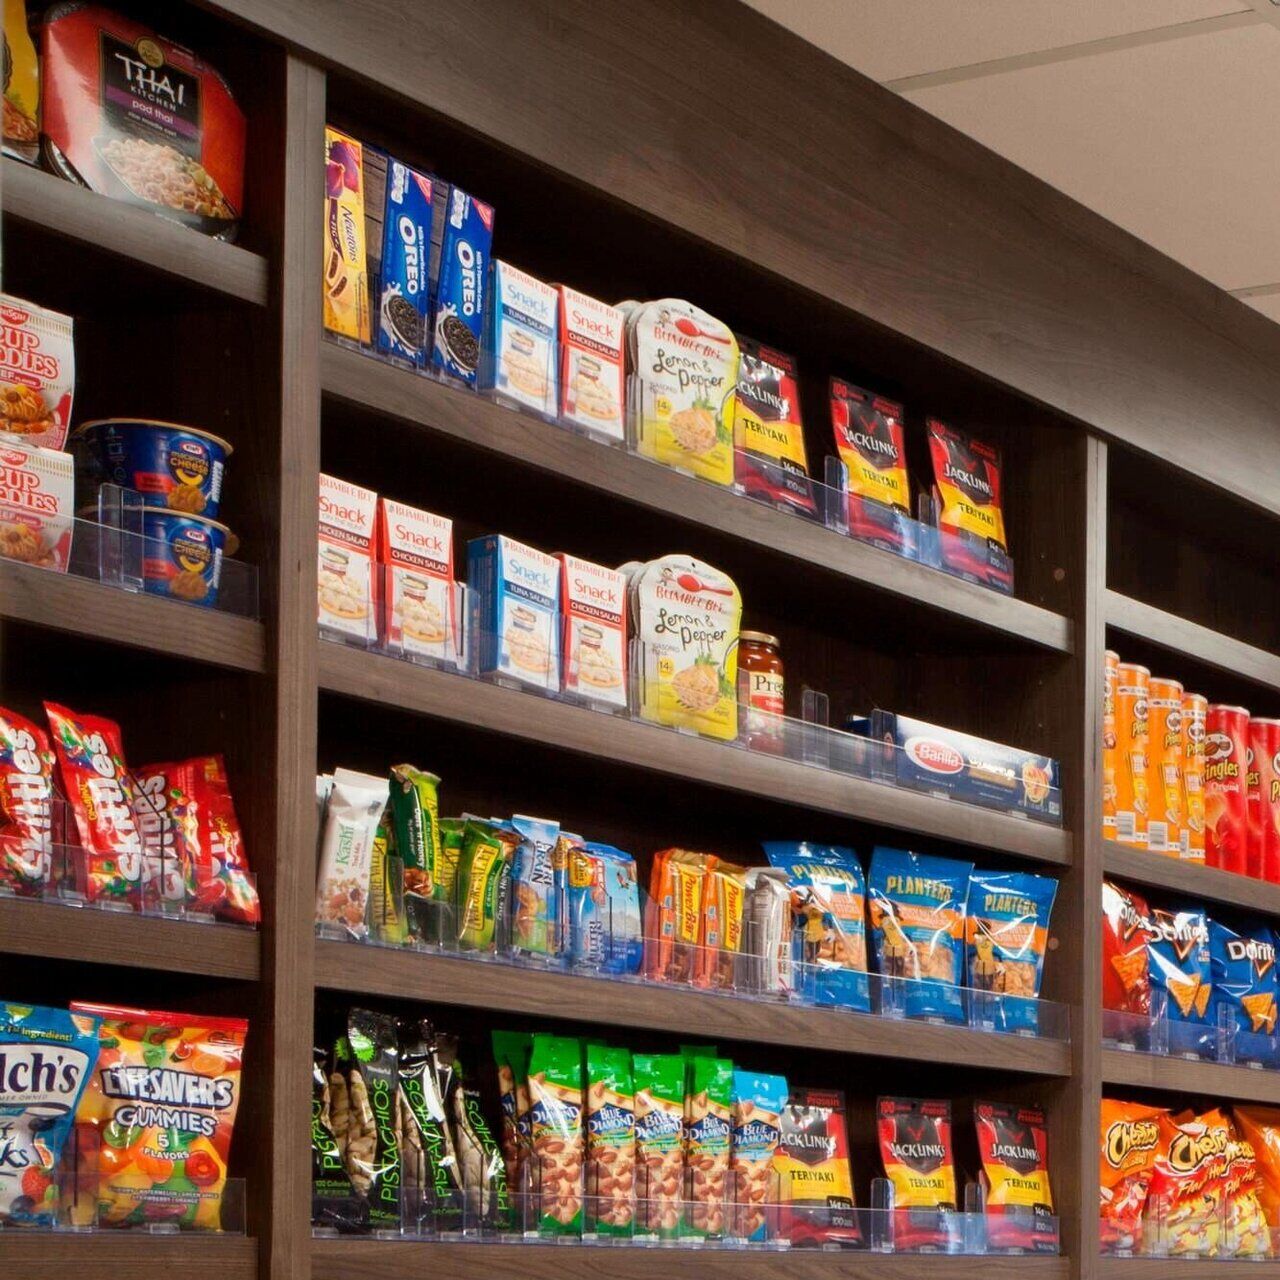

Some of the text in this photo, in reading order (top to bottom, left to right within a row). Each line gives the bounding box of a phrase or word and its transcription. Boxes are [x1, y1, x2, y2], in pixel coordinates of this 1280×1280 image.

[114, 52, 185, 104] THAI
[130, 86, 176, 112] KITCHEN
[132, 100, 174, 125] pad thai
[341, 205, 358, 264] Newtons
[399, 216, 417, 295] OREO
[457, 241, 475, 316] OREO
[508, 284, 549, 315] Snack
[572, 310, 614, 339] Snack
[678, 368, 724, 393] Pepper
[743, 418, 789, 445] TERIYAKI
[862, 466, 898, 491] TERIYAKI
[319, 496, 366, 526] Snack
[957, 502, 995, 526] TERIYAKI
[319, 525, 369, 547] HICKEN SALAD
[396, 524, 442, 552] Snack
[391, 550, 448, 574] CHICKEN SALAD
[510, 559, 551, 586] Snack
[511, 584, 550, 607] TUNA SALAD
[574, 578, 617, 604] Snack
[571, 603, 621, 624] CHICKEN SALAD
[655, 608, 704, 634] Lemon
[681, 628, 727, 651] Pepper
[755, 676, 784, 696] Preg
[336, 823, 354, 867] Kashi
[886, 875, 954, 902] PLANTERS
[683, 873, 699, 942] PowerBar
[727, 885, 743, 945] PowerBar
[984, 893, 1039, 918] PLANTERS
[0, 1052, 79, 1094] lch's
[115, 1105, 216, 1137] GUMMIES
[589, 1113, 634, 1131] DIAMOND
[600, 1106, 621, 1120] BLUE
[157, 1133, 169, 1147] 5
[373, 1078, 400, 1202] PISTACHIOS
[688, 1124, 729, 1140] DIAMOND
[733, 1130, 778, 1144] DIAMOND
[743, 1124, 767, 1136] BLUE
[142, 1147, 190, 1161] FLAVORS
[890, 1142, 916, 1157] JACK
[991, 1142, 1017, 1158] JACK
[790, 1169, 834, 1183] TERIYAKI
[908, 1177, 945, 1190] TERIYAKI
[1004, 1177, 1040, 1192] TERIYAKI
